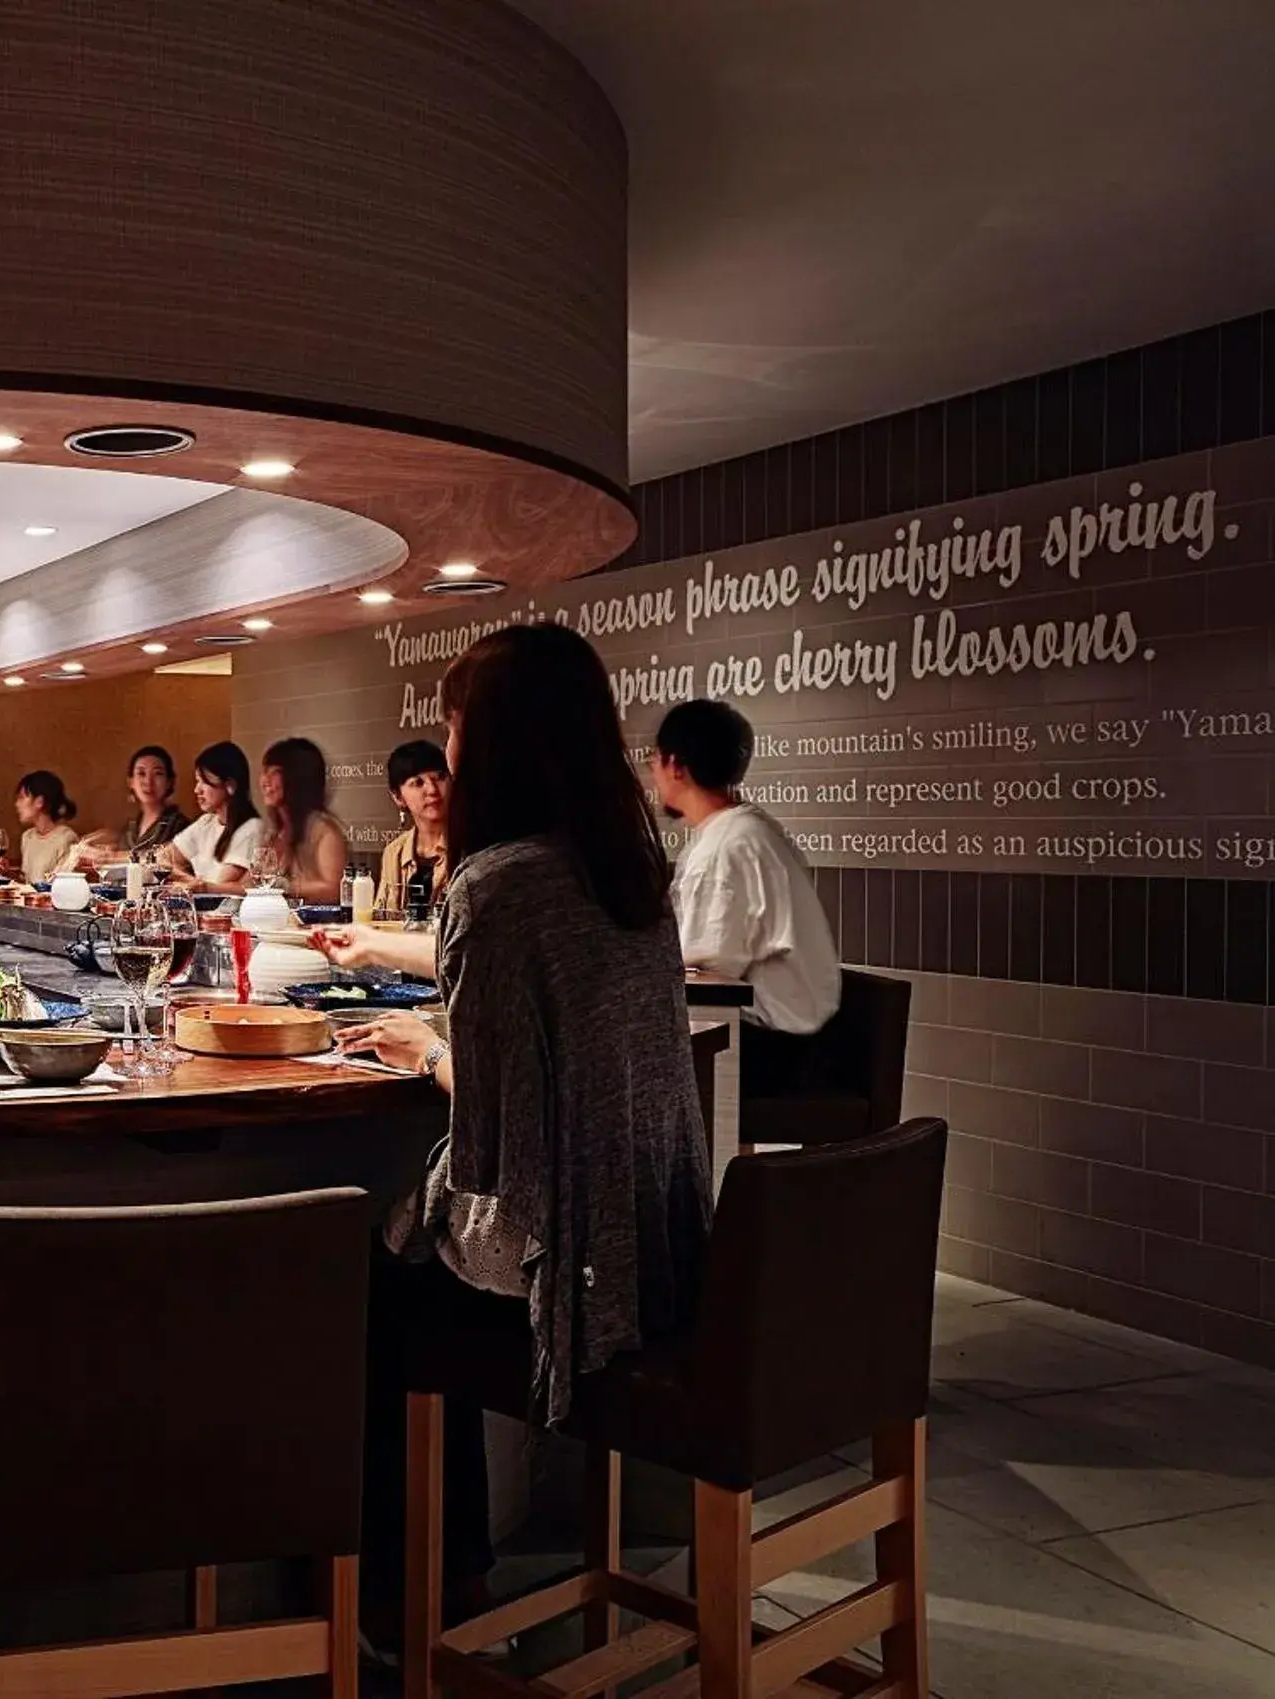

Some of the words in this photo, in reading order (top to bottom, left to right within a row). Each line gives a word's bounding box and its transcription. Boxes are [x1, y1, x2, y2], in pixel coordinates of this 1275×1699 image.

[576, 588, 676, 637] season
[686, 560, 800, 635] phrase
[811, 516, 1022, 611] signifying
[1040, 481, 1240, 580] spring.
[398, 680, 445, 729] And
[706, 655, 765, 699] are
[774, 629, 898, 701] cherry
[911, 608, 1156, 680] blossoms.
[366, 760, 385, 777] the
[753, 735, 791, 758] like
[797, 725, 925, 755] mountain's
[931, 722, 1037, 752] smiling,
[1046, 721, 1087, 744] we
[1097, 719, 1150, 748] say
[816, 778, 857, 802] and
[866, 777, 983, 808] represent
[993, 772, 1062, 808] good
[1072, 775, 1167, 805] crops.
[842, 829, 947, 859] regarded
[957, 833, 984, 856] as
[993, 833, 1026, 857] an
[1036, 831, 1203, 864] auspicious
